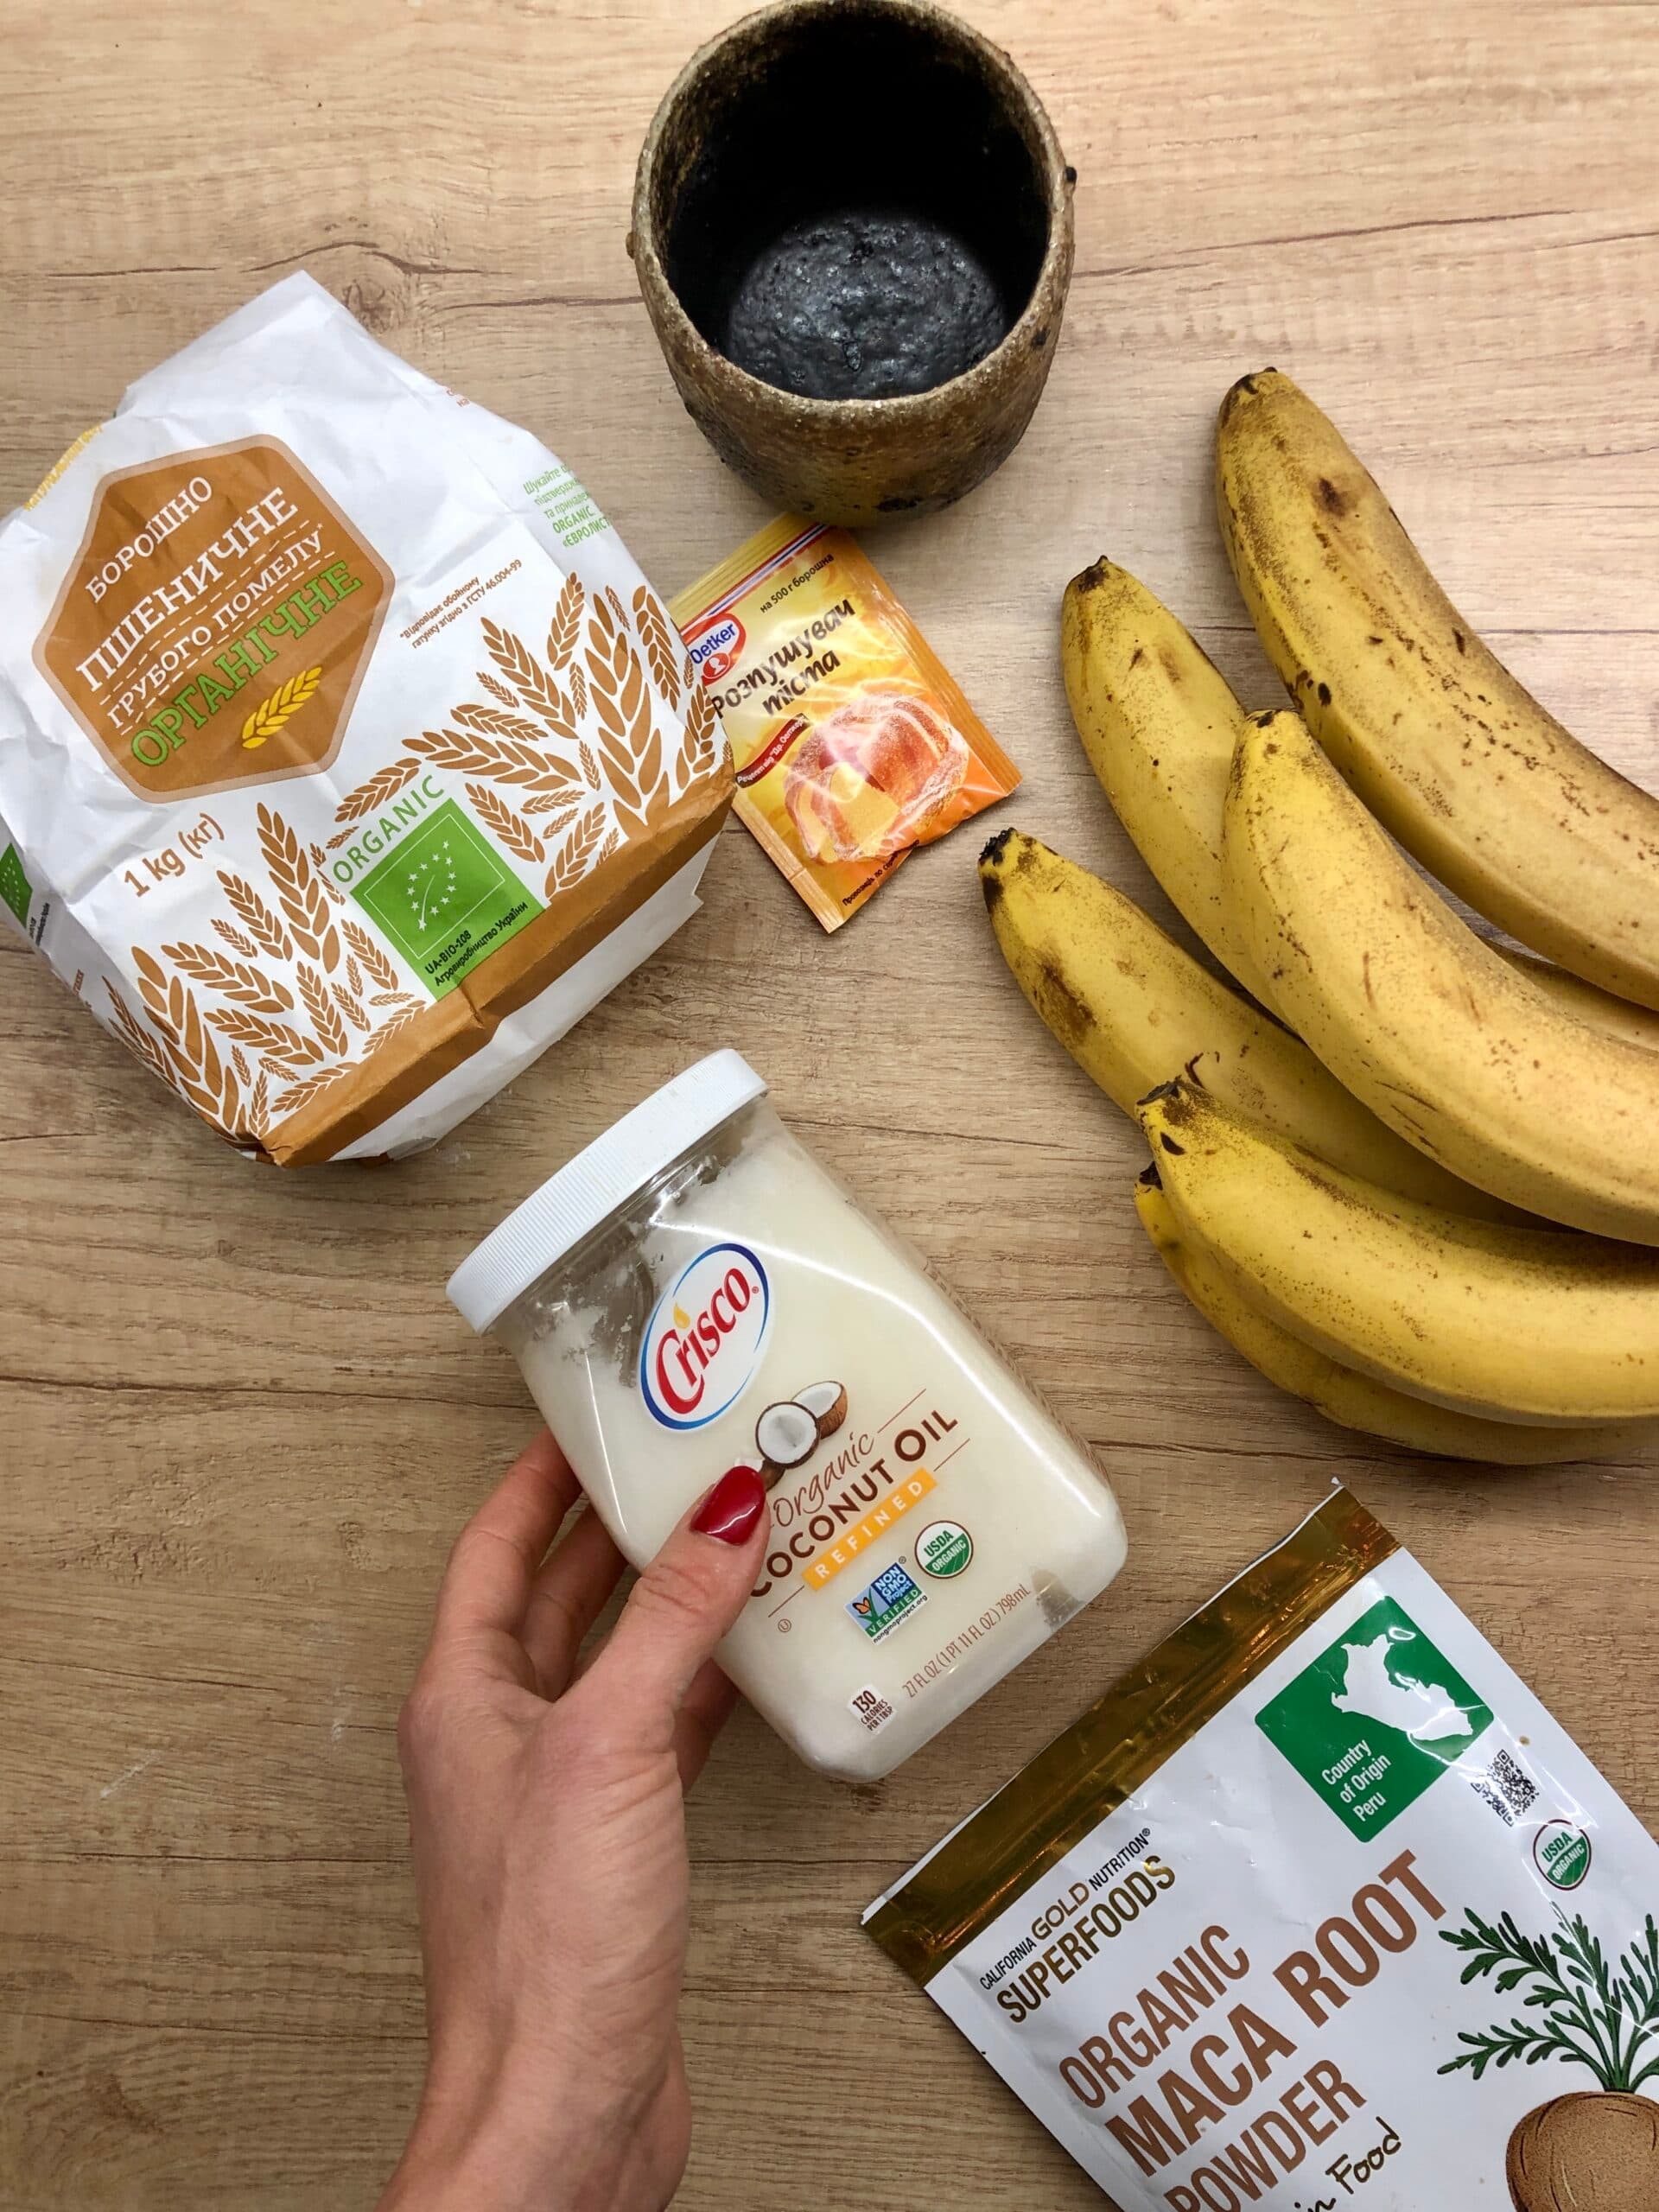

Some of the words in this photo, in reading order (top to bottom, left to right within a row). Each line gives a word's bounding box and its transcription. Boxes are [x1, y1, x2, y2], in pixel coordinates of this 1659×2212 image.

[85, 476, 213, 603] БОРОШНО
[552, 505, 595, 534] ORGANIC
[75, 486, 299, 692] ПШЕНИЧНЕ
[411, 623, 440, 649] гатунку
[438, 607, 462, 627] згідно
[466, 586, 486, 605] ГСТУ
[486, 559, 522, 590] 46.004-99
[442, 576, 480, 607] обойному
[760, 602, 772, 613] на
[771, 587, 789, 604] 500
[791, 553, 834, 588] борошна
[130, 560, 364, 767] ОРГАНІЧНЕ
[690, 623, 736, 664] Oetker
[711, 599, 855, 719] Розпушувач
[106, 625, 213, 729] ГРУБОГО
[762, 650, 841, 716] тіста
[332, 774, 444, 883] ORGANIC
[124, 870, 150, 898] 1
[142, 848, 186, 881] kg
[178, 812, 226, 860] (кг)
[424, 930, 472, 974] UA-BIO-108
[435, 928, 498, 986] Агровиробництво
[495, 901, 528, 931] України
[894, 1410, 958, 1462] OIL
[815, 1481, 923, 1579] REFINED
[924, 1530, 954, 1557] USDA
[931, 1540, 966, 1571] ORGANIC
[875, 1566, 901, 1591] NON
[881, 1574, 906, 1598] GMO
[886, 1580, 912, 1604] Project
[869, 1588, 918, 1633] VERIFIED
[873, 1594, 928, 1643] nongmoproject.org
[902, 1681, 914, 1698] 27
[914, 1674, 931, 1689] FL
[924, 1660, 942, 1678] OZ
[946, 1641, 963, 1660] PT
[957, 1632, 973, 1649] 11
[968, 1625, 985, 1641] FL
[995, 1583, 1032, 1615] 798mL
[852, 1690, 876, 1713] 130
[861, 1699, 888, 1725] CALORIES
[867, 1719, 880, 1732] PER
[1321, 1738, 1372, 1786] Country
[1339, 1785, 1353, 1803] of
[1351, 1753, 1392, 1794] Origin
[1352, 1790, 1387, 1822] Peru
[1541, 1830, 1573, 1863] USDA
[1552, 1843, 1585, 1881] ORGANIC
[980, 1937, 1038, 1991] CALIFORNIA
[1031, 1882, 1090, 1941] GOLD
[997, 1855, 1175, 2024] SUPERFOODS
[1058, 1925, 1249, 2109] ORGANIC
[1104, 2003, 1298, 2177] MACA
[1272, 1848, 1446, 2028] ROOT
[1164, 2059, 1367, 2212] POWDER
[1325, 2116, 1402, 2195] Food
